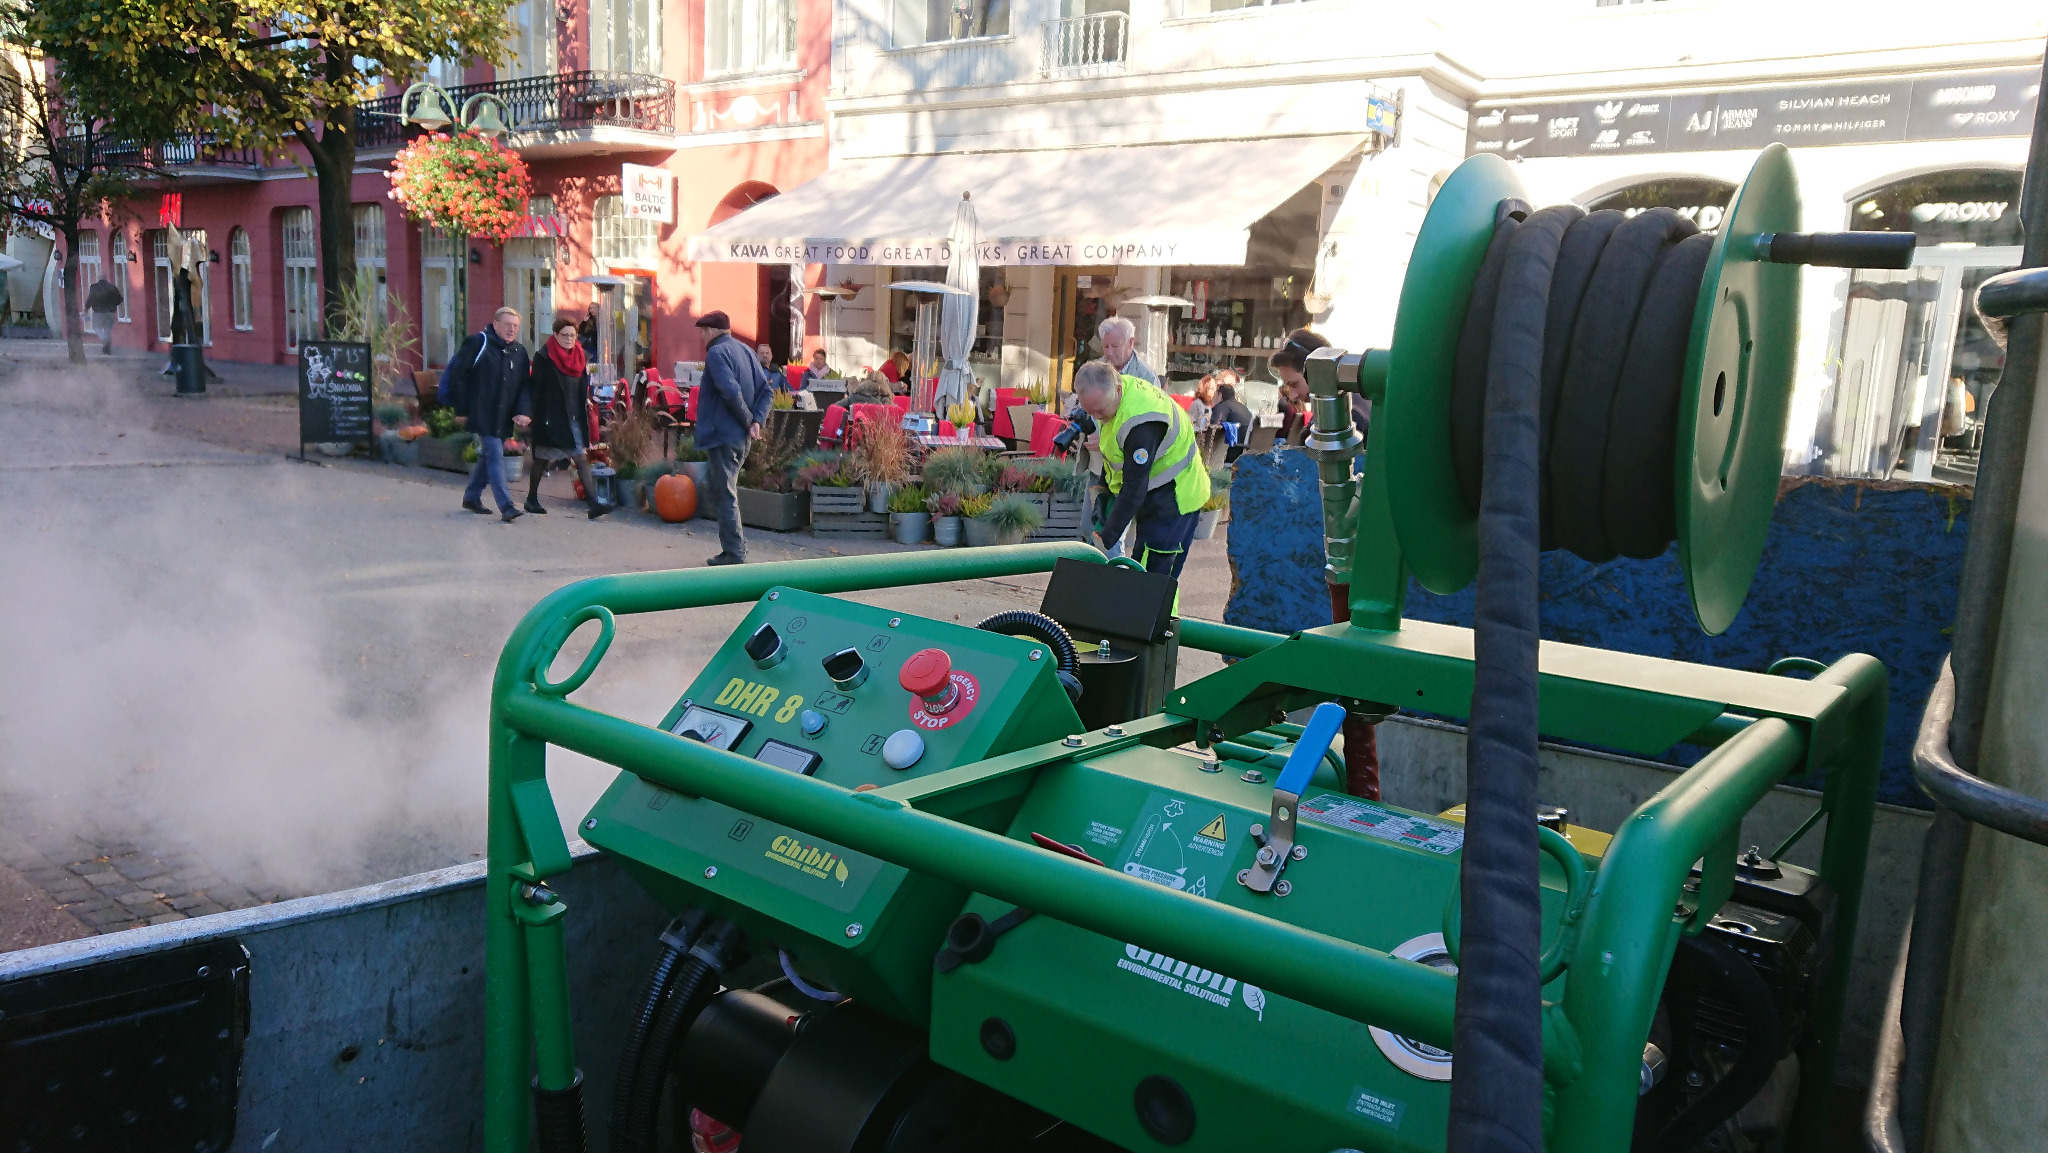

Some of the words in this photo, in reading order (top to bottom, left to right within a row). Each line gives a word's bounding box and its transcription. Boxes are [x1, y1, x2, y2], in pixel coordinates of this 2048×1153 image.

[1779, 96, 1835, 111] SILVIAN
[1839, 93, 1891, 107] HEACH
[1686, 110, 1712, 131] AJ
[1721, 108, 1758, 120] ARMANI
[1975, 110, 2020, 124] ROXY
[1549, 116, 1580, 129] LOFT
[1723, 118, 1753, 129] JEANS
[1776, 122, 1819, 133] TOMMY
[1836, 119, 1886, 130] HILFIGER
[1549, 128, 1579, 139] SPORT
[635, 192, 666, 205] BALTIC
[640, 204, 662, 215] GYM
[1942, 201, 2009, 222] ROXY
[730, 244, 769, 258] KAVA
[774, 245, 819, 259] GREAT
[826, 246, 874, 261] FOOD,
[883, 246, 933, 260] GREAT
[1017, 244, 1073, 260] GREAT
[1083, 242, 1178, 259] COMPANY
[949, 674, 976, 702] RGENCY
[713, 677, 780, 718] DHR
[774, 694, 804, 724] 8
[913, 710, 949, 728] STOP
[1187, 842, 1224, 858] ADVERTENCIA
[1192, 835, 1226, 850] WARNING
[771, 835, 838, 872] Ghibli
[1116, 958, 1184, 990] ENVIRONMENTAL
[1183, 983, 1231, 1008] SOLUTIONS
[1361, 1093, 1380, 1104] WATER
